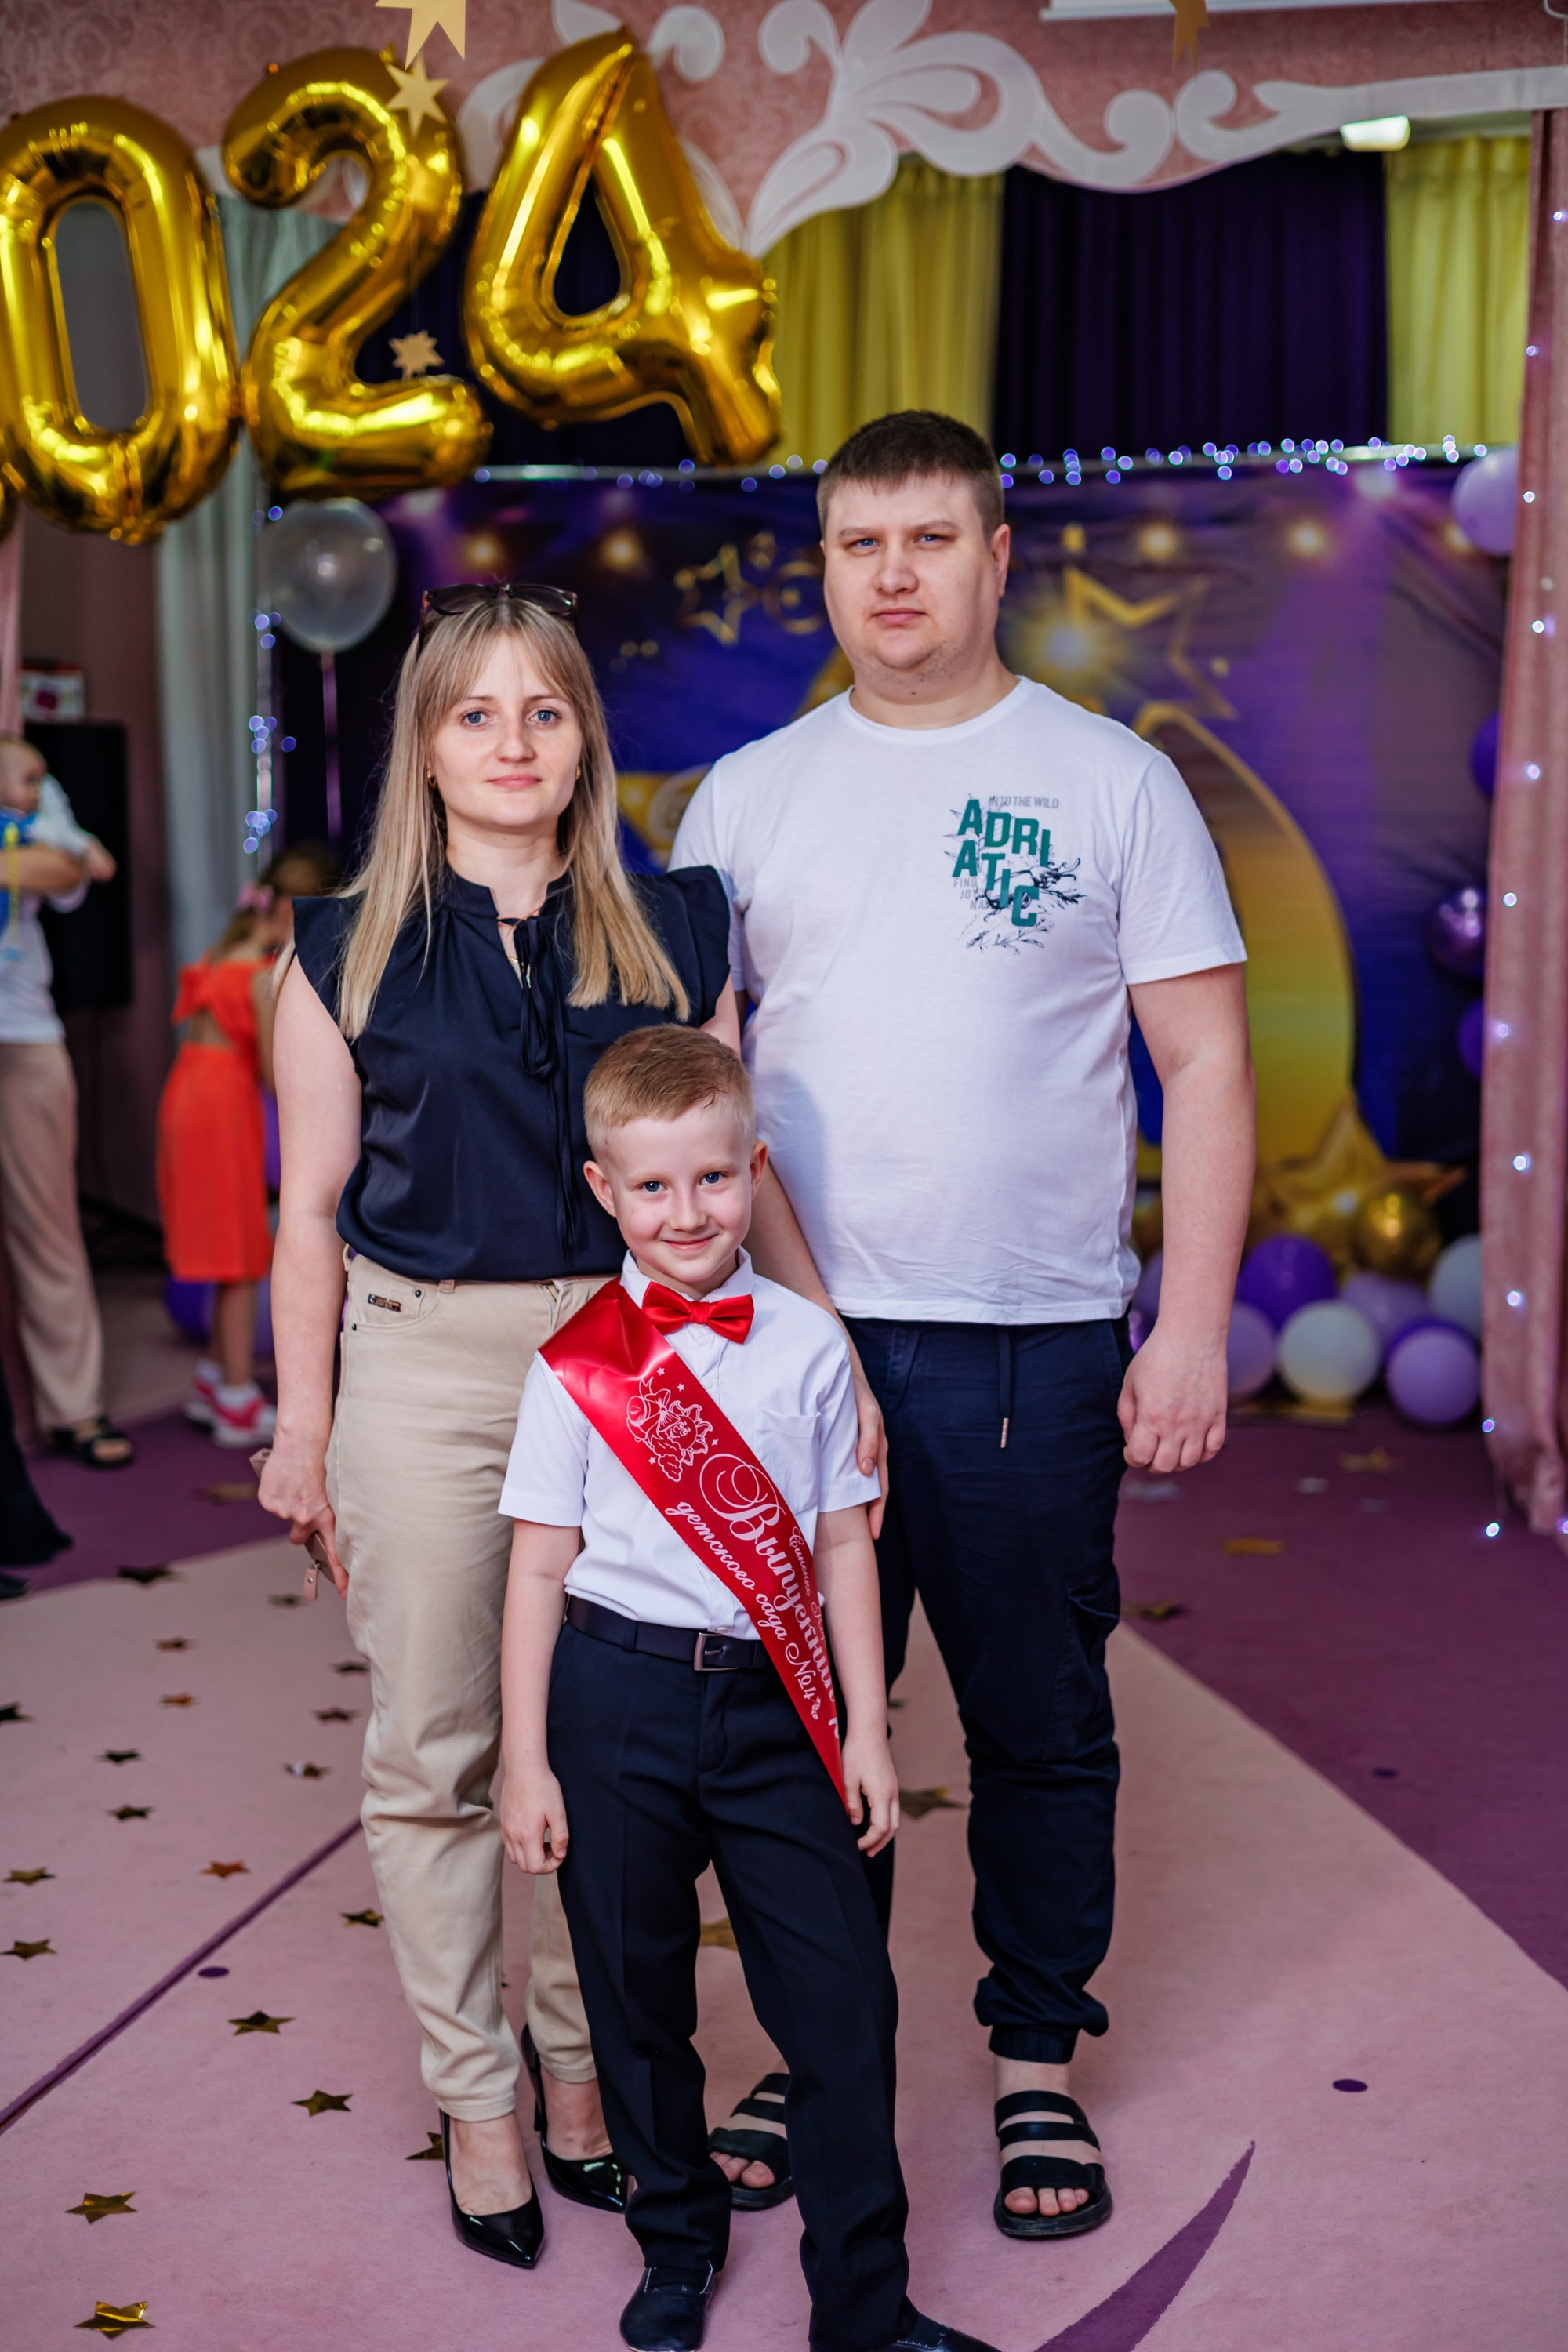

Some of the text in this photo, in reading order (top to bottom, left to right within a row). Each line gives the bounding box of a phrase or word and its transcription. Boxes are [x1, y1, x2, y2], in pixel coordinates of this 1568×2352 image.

[0, 26, 782, 546] 024
[957, 799, 1051, 867] ADRI
[1013, 796, 1032, 808] THE
[1033, 797, 1059, 809] WILD
[952, 840, 1040, 927] ATIC
[953, 877, 978, 888] FIND
[665, 1501, 755, 1591] детского
[756, 1593, 788, 1641] сада
